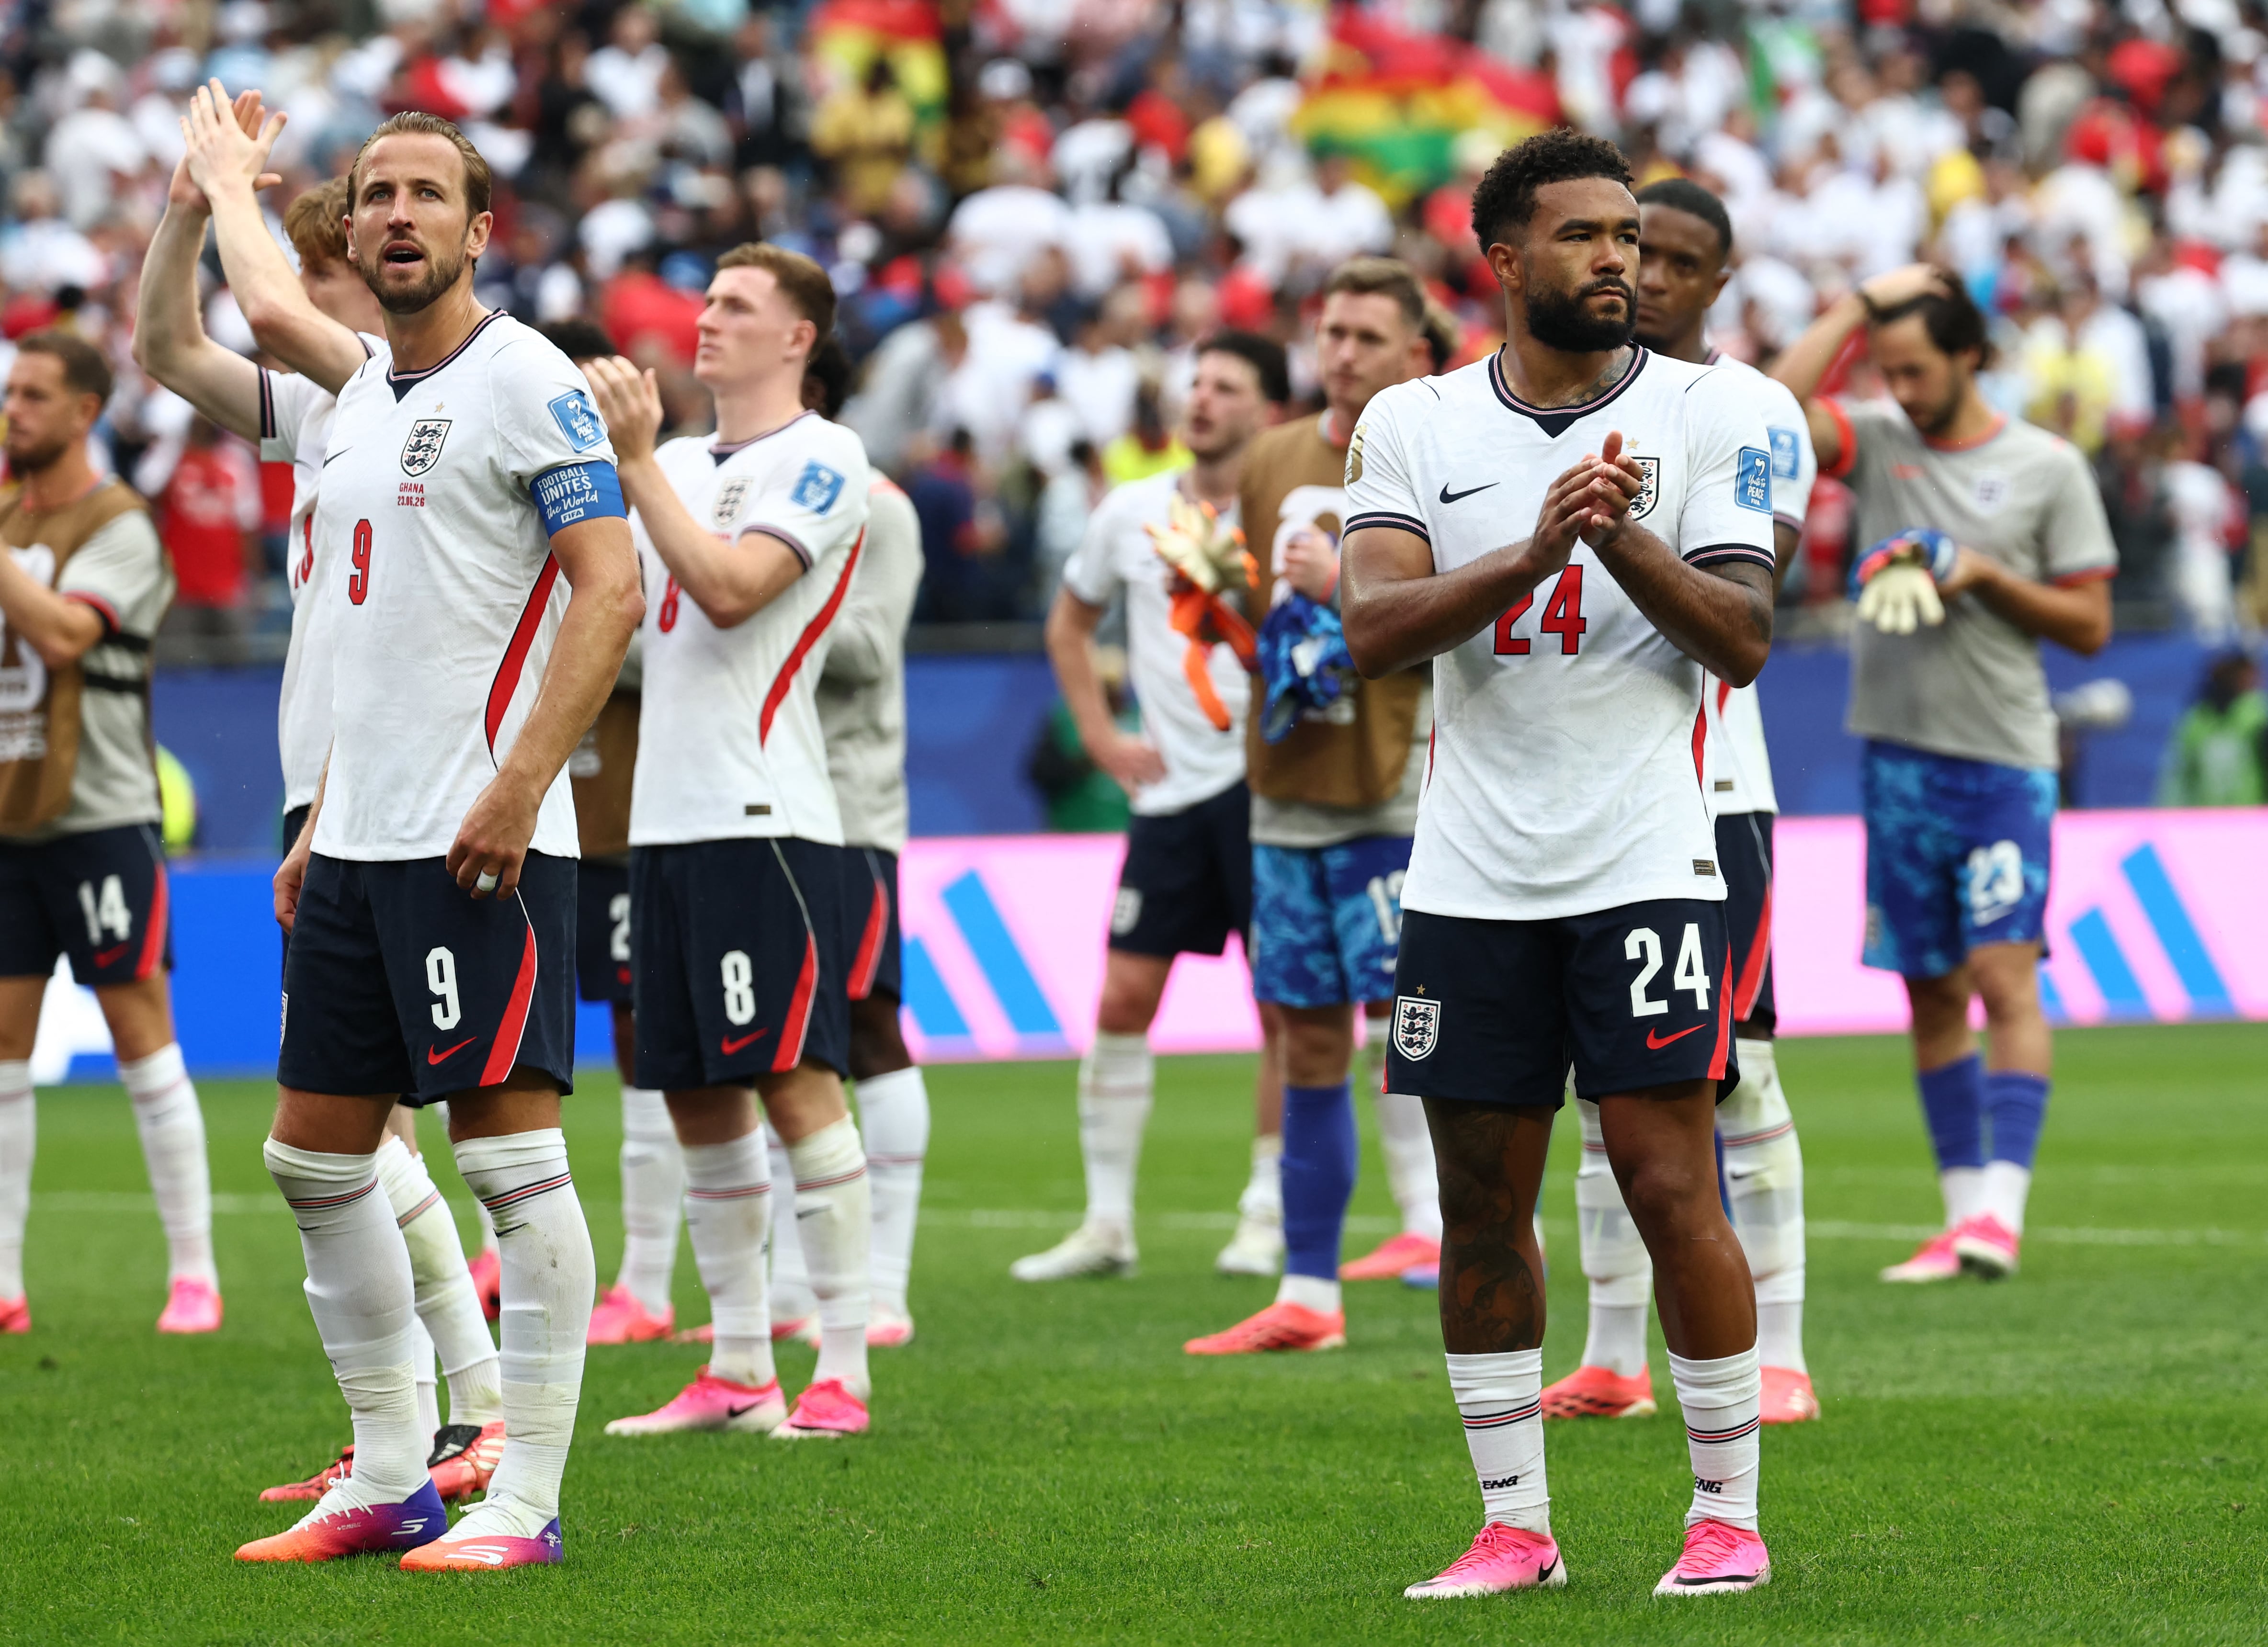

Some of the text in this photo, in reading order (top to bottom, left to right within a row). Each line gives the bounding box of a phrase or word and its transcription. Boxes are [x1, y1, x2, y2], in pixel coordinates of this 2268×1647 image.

[576, 422, 594, 439] PEACE
[399, 483, 424, 494] GHANA
[537, 466, 588, 492] FOOTBALL
[541, 475, 592, 505] UNITES
[1747, 485, 1764, 500] PEACE
[1748, 474, 1760, 485] Unite
[397, 496, 425, 507] 23.06.26
[546, 490, 598, 520] the World
[562, 508, 583, 522] FIFA
[349, 519, 372, 605] 9
[1494, 564, 1587, 655] 24
[1967, 839, 2025, 907] 23
[77, 874, 132, 947] 14
[1624, 923, 1711, 1017] 24
[425, 946, 461, 1031] 9
[720, 949, 756, 1026] 8
